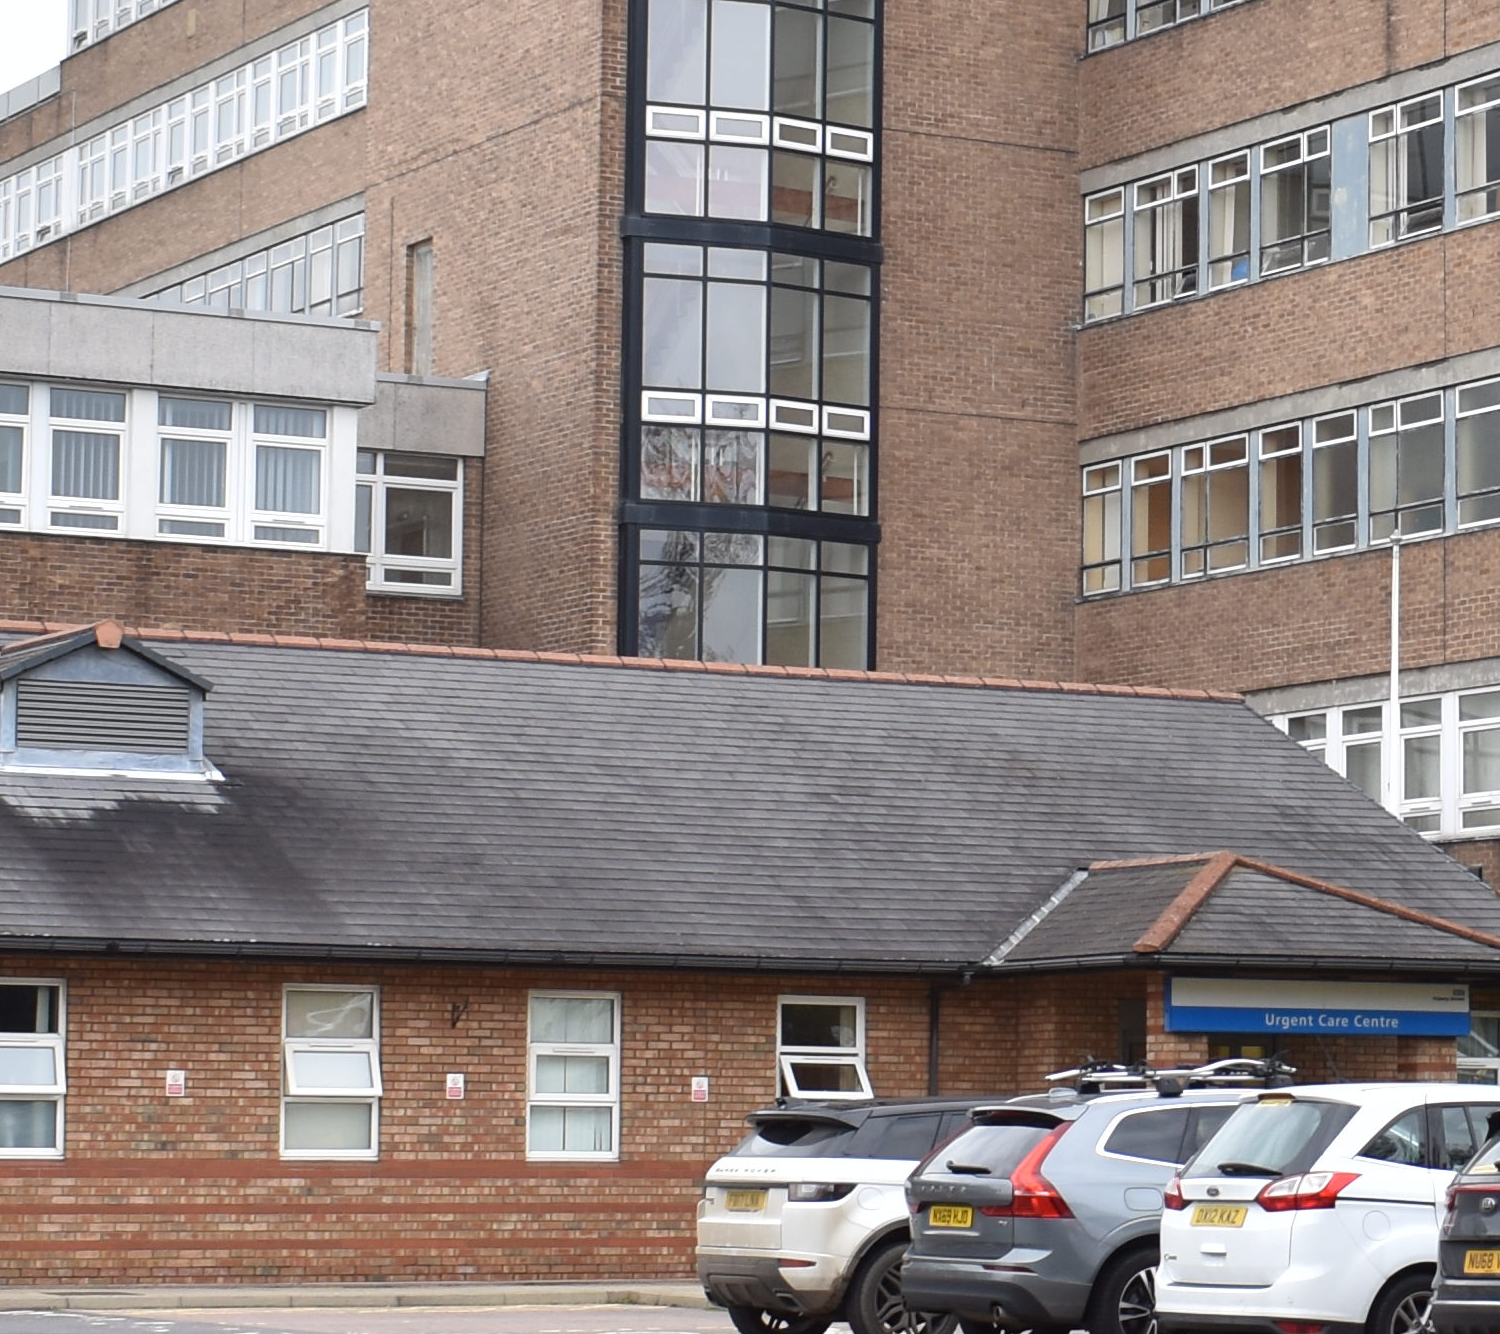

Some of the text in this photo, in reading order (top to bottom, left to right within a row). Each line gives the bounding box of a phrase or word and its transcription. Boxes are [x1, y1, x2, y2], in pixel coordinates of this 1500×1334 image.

[1265, 1013, 1399, 1030] Urgent Care Centre
